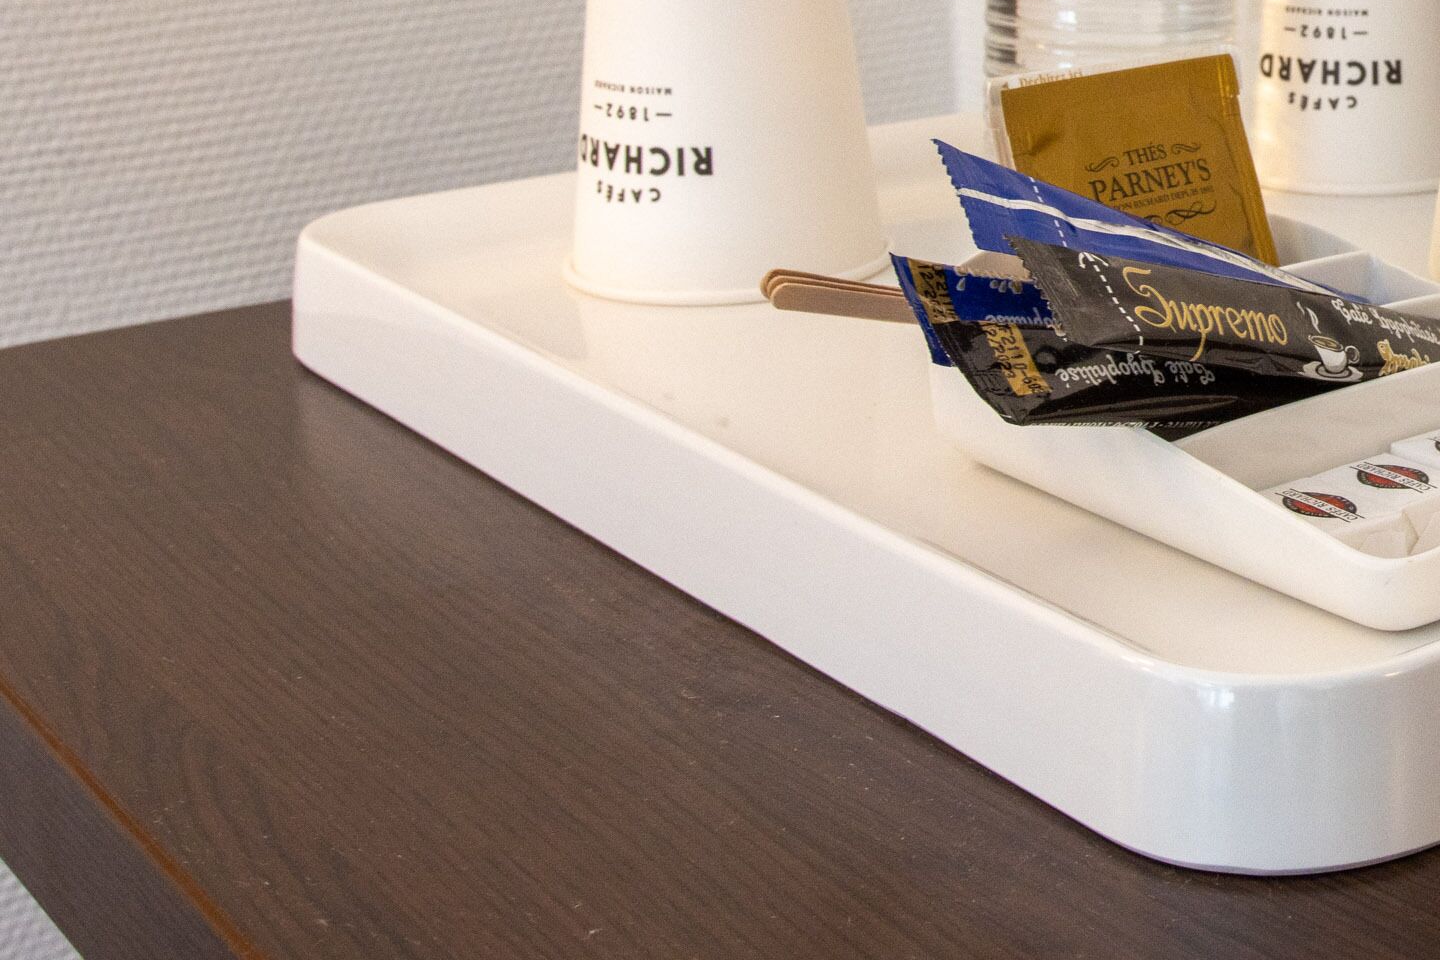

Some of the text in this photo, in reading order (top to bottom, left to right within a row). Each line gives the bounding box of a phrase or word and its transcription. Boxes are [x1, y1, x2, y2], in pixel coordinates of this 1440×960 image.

[1260, 54, 1403, 87] RICHARD
[629, 86, 672, 96] MAISON
[1287, 92, 1358, 112] CAFÉS
[580, 133, 713, 177] RICHARD
[1123, 141, 1168, 166] THÉS
[595, 180, 661, 205] CAFÉS
[1088, 158, 1212, 204] PARNEY'S
[1122, 265, 1288, 362] Supremo
[1054, 352, 1216, 389] Café Lyophilisé
